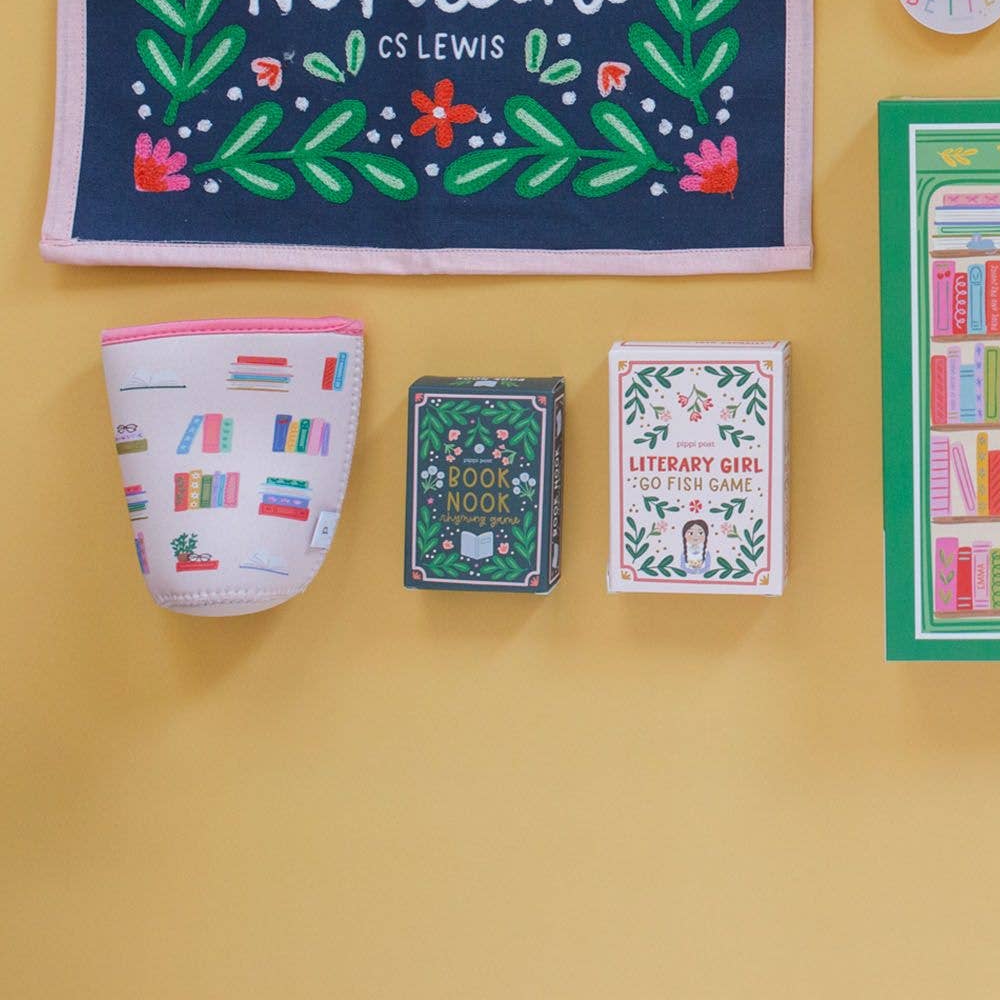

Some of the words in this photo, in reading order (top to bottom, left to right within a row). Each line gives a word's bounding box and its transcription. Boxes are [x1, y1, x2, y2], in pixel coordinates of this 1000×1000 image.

[378, 33, 407, 59] CS
[418, 33, 505, 60] LEWIS
[677, 440, 697, 449] pippi
[698, 441, 716, 449] post
[629, 456, 714, 473] LITERARY
[720, 457, 763, 474] GIRL
[449, 466, 510, 489] BOOK
[639, 476, 662, 491] GO
[667, 476, 703, 491] FISH
[709, 477, 752, 493] GAME
[447, 491, 510, 514] NOOK
[489, 514, 521, 528] game
[977, 562, 985, 591] EMMA
